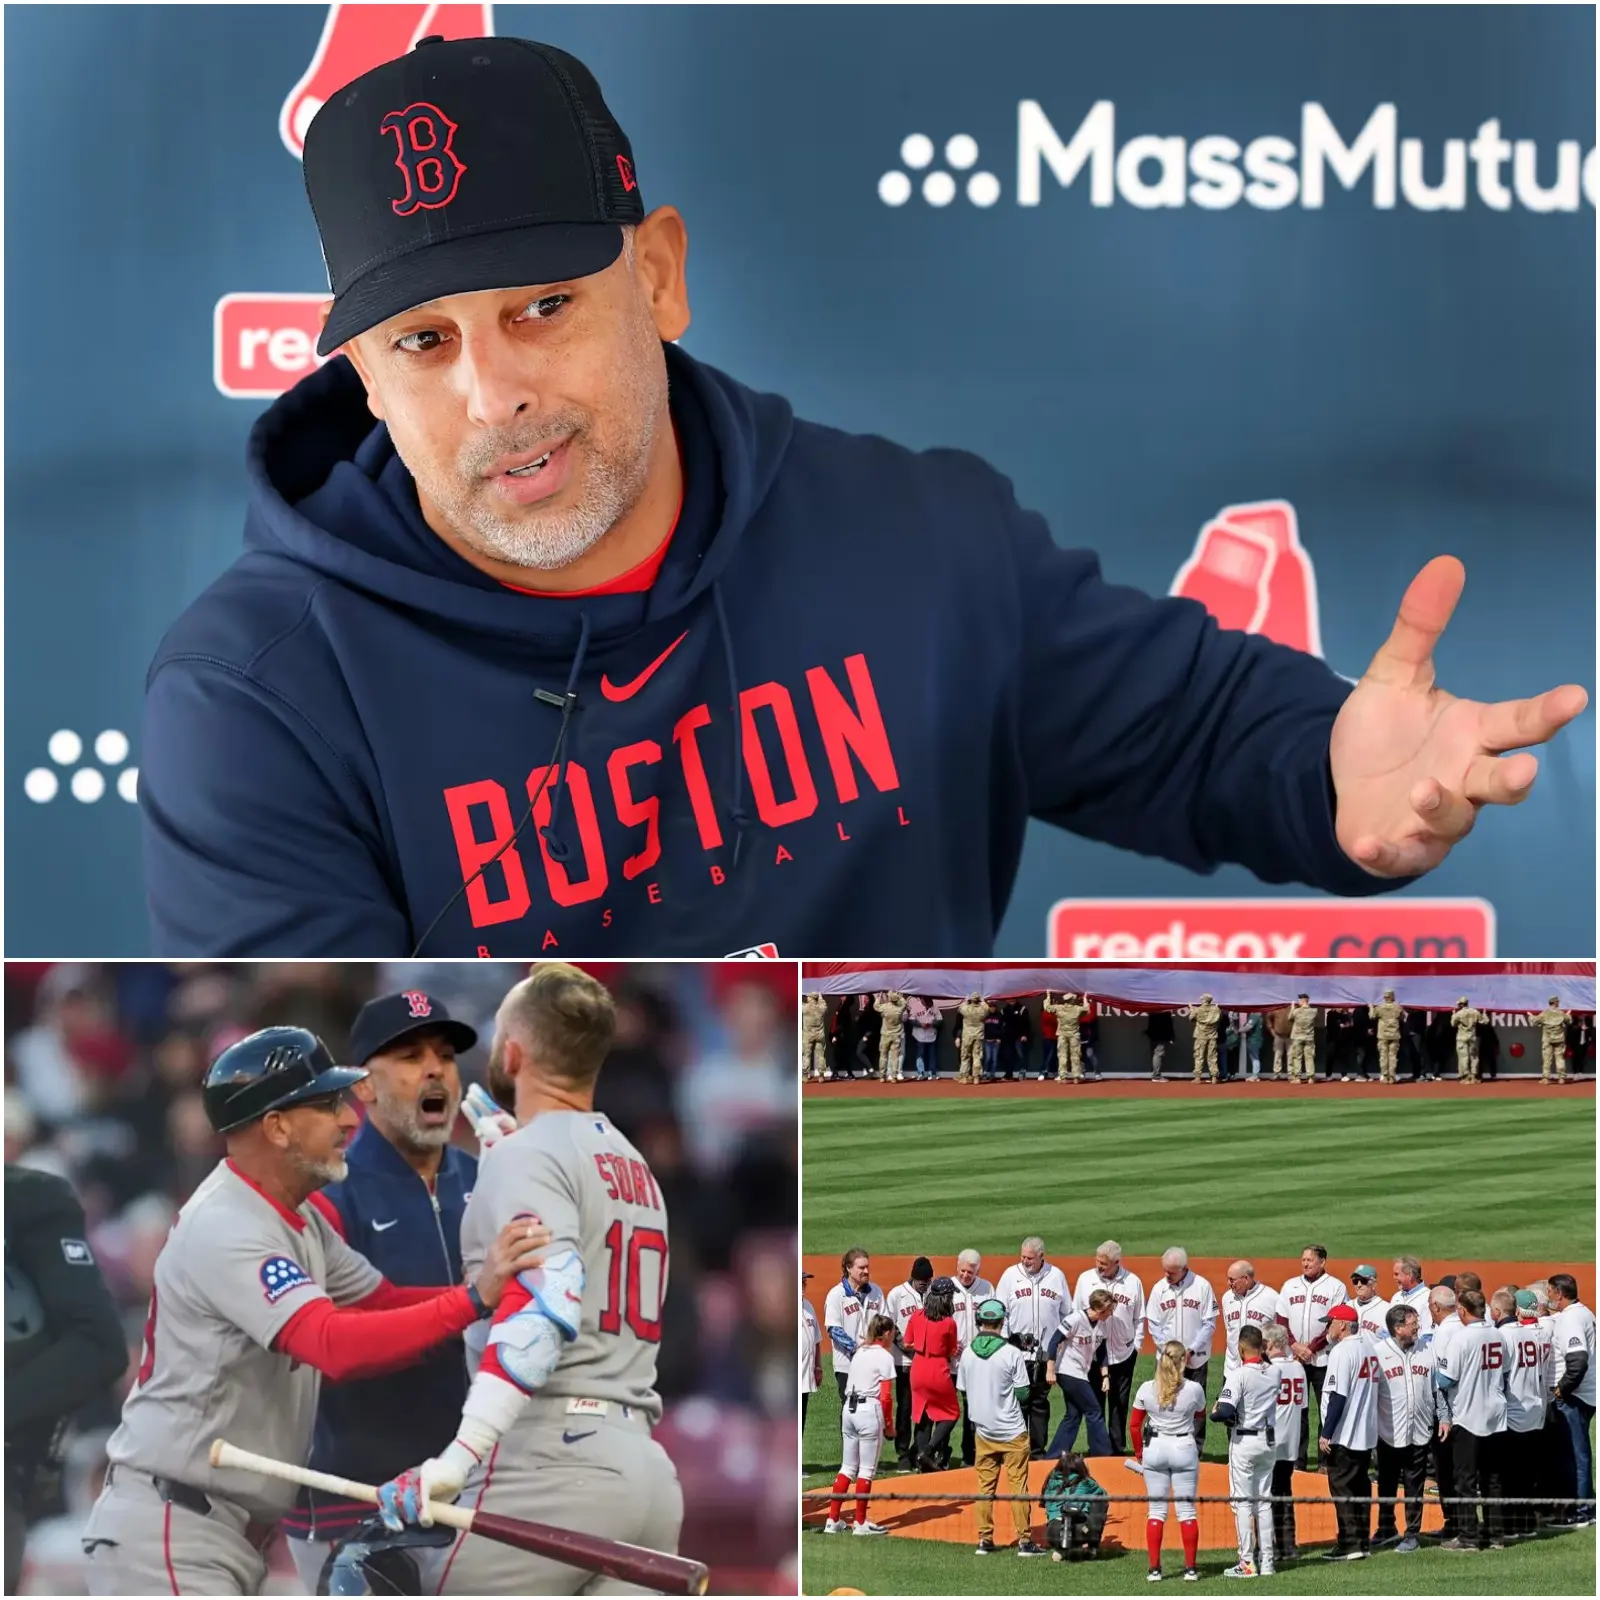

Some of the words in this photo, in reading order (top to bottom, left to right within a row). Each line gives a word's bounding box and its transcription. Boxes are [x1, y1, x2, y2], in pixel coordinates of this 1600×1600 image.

[380, 102, 467, 216] B
[443, 653, 900, 928] BOSTON
[476, 806, 911, 958] BASEBALL
[599, 1219, 668, 1344] 10
[1015, 1287, 1032, 1299] RED
[1040, 1287, 1057, 1300] SOX
[844, 1302, 860, 1316] RED
[1160, 1299, 1176, 1312] RED
[1183, 1298, 1200, 1310] SOX
[1289, 1295, 1305, 1306] RED
[1312, 1294, 1329, 1306] SOX
[1247, 1310, 1265, 1322] SOX
[1361, 1320, 1380, 1332] SOX
[1481, 1342, 1503, 1371] 15
[1518, 1341, 1538, 1368] 19
[1358, 1356, 1379, 1383] 42
[1385, 1366, 1404, 1380] RED
[1412, 1365, 1430, 1378] SOX
[1276, 1378, 1304, 1405] 35
